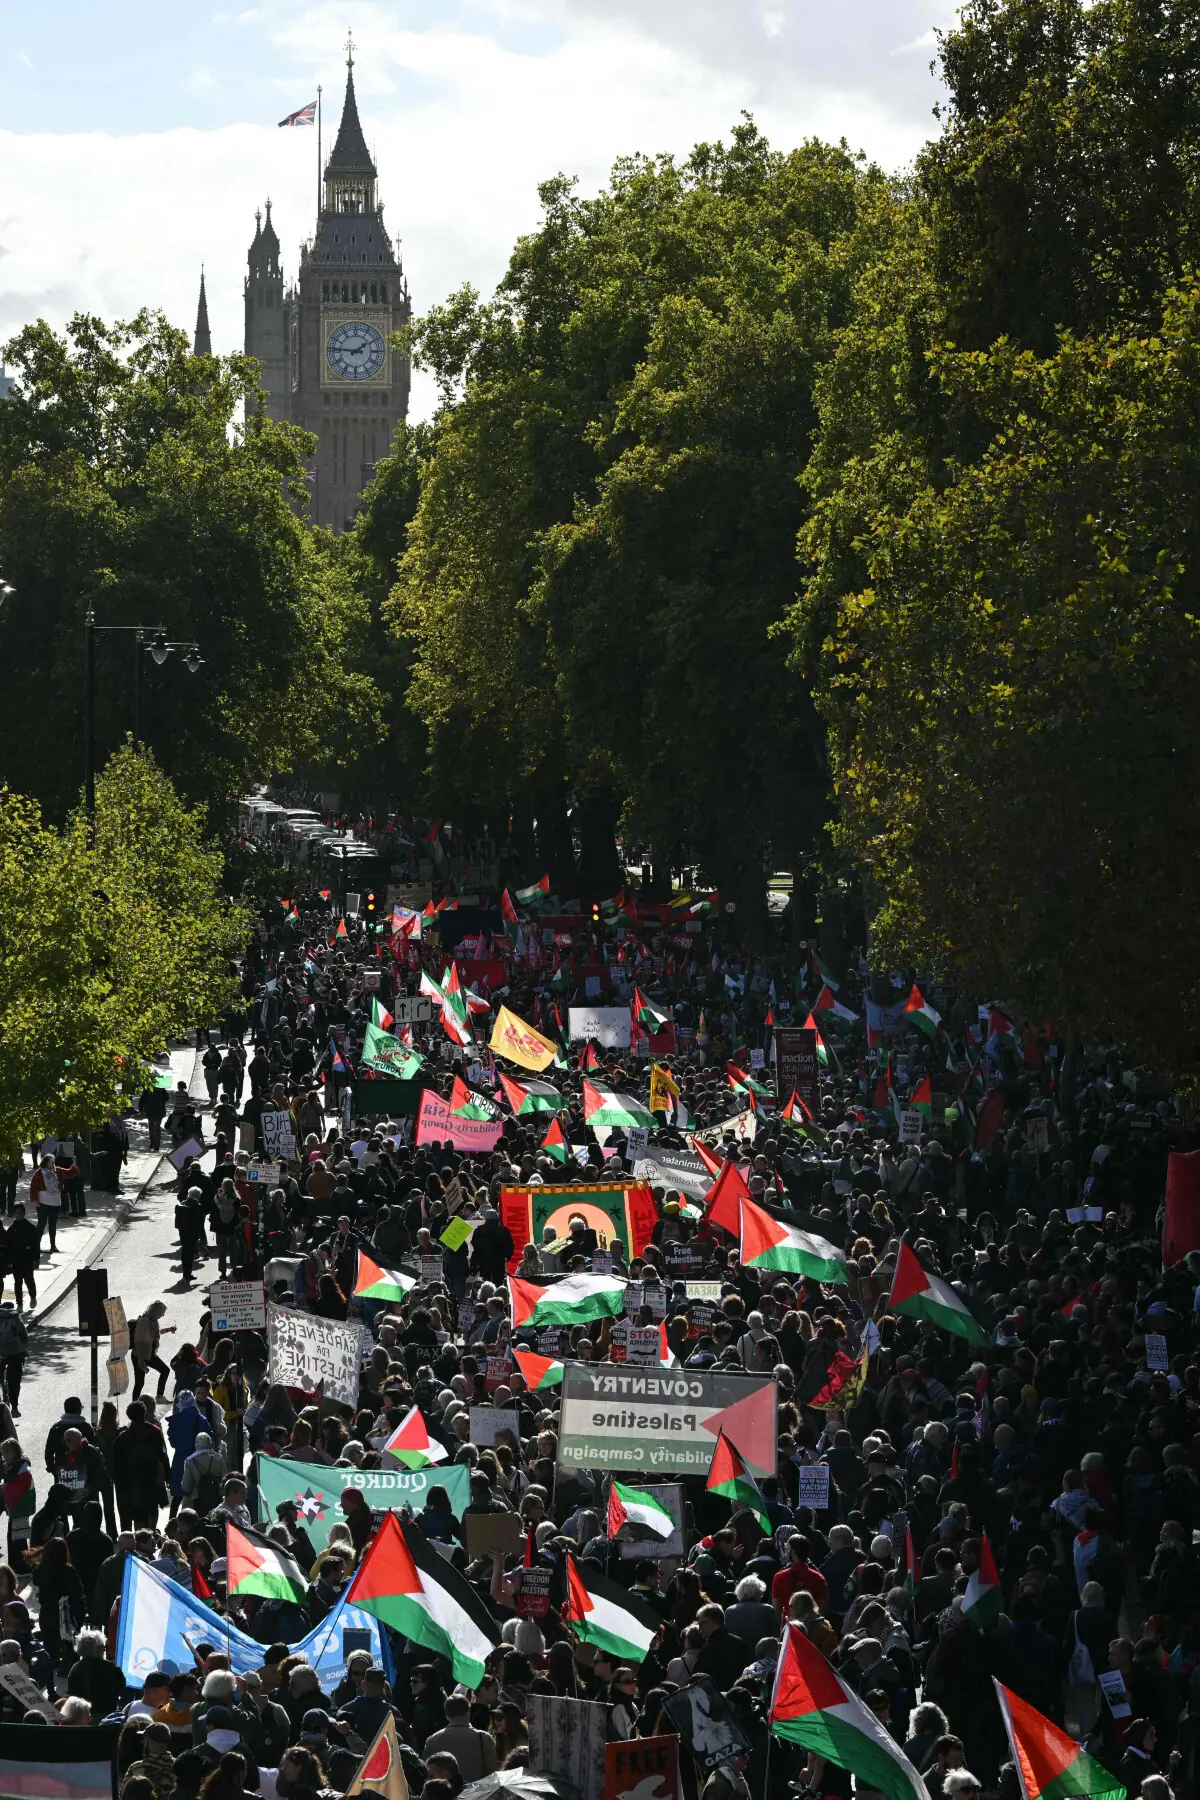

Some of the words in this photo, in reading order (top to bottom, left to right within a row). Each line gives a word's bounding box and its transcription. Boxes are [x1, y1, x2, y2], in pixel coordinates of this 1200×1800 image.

[781, 1053, 814, 1063] inaction
[250, 1171, 258, 1180] P
[673, 1246, 693, 1255] Free
[664, 1255, 703, 1265] Palestine
[629, 1330, 660, 1340] STOP
[628, 1339, 660, 1347] ARMING
[60, 1468, 79, 1479] Free
[523, 1574, 551, 1584] FREEDOM
[520, 1585, 550, 1596] PALESTINE
[704, 1743, 742, 1767] GAZA
[615, 1746, 669, 1776] FREE
